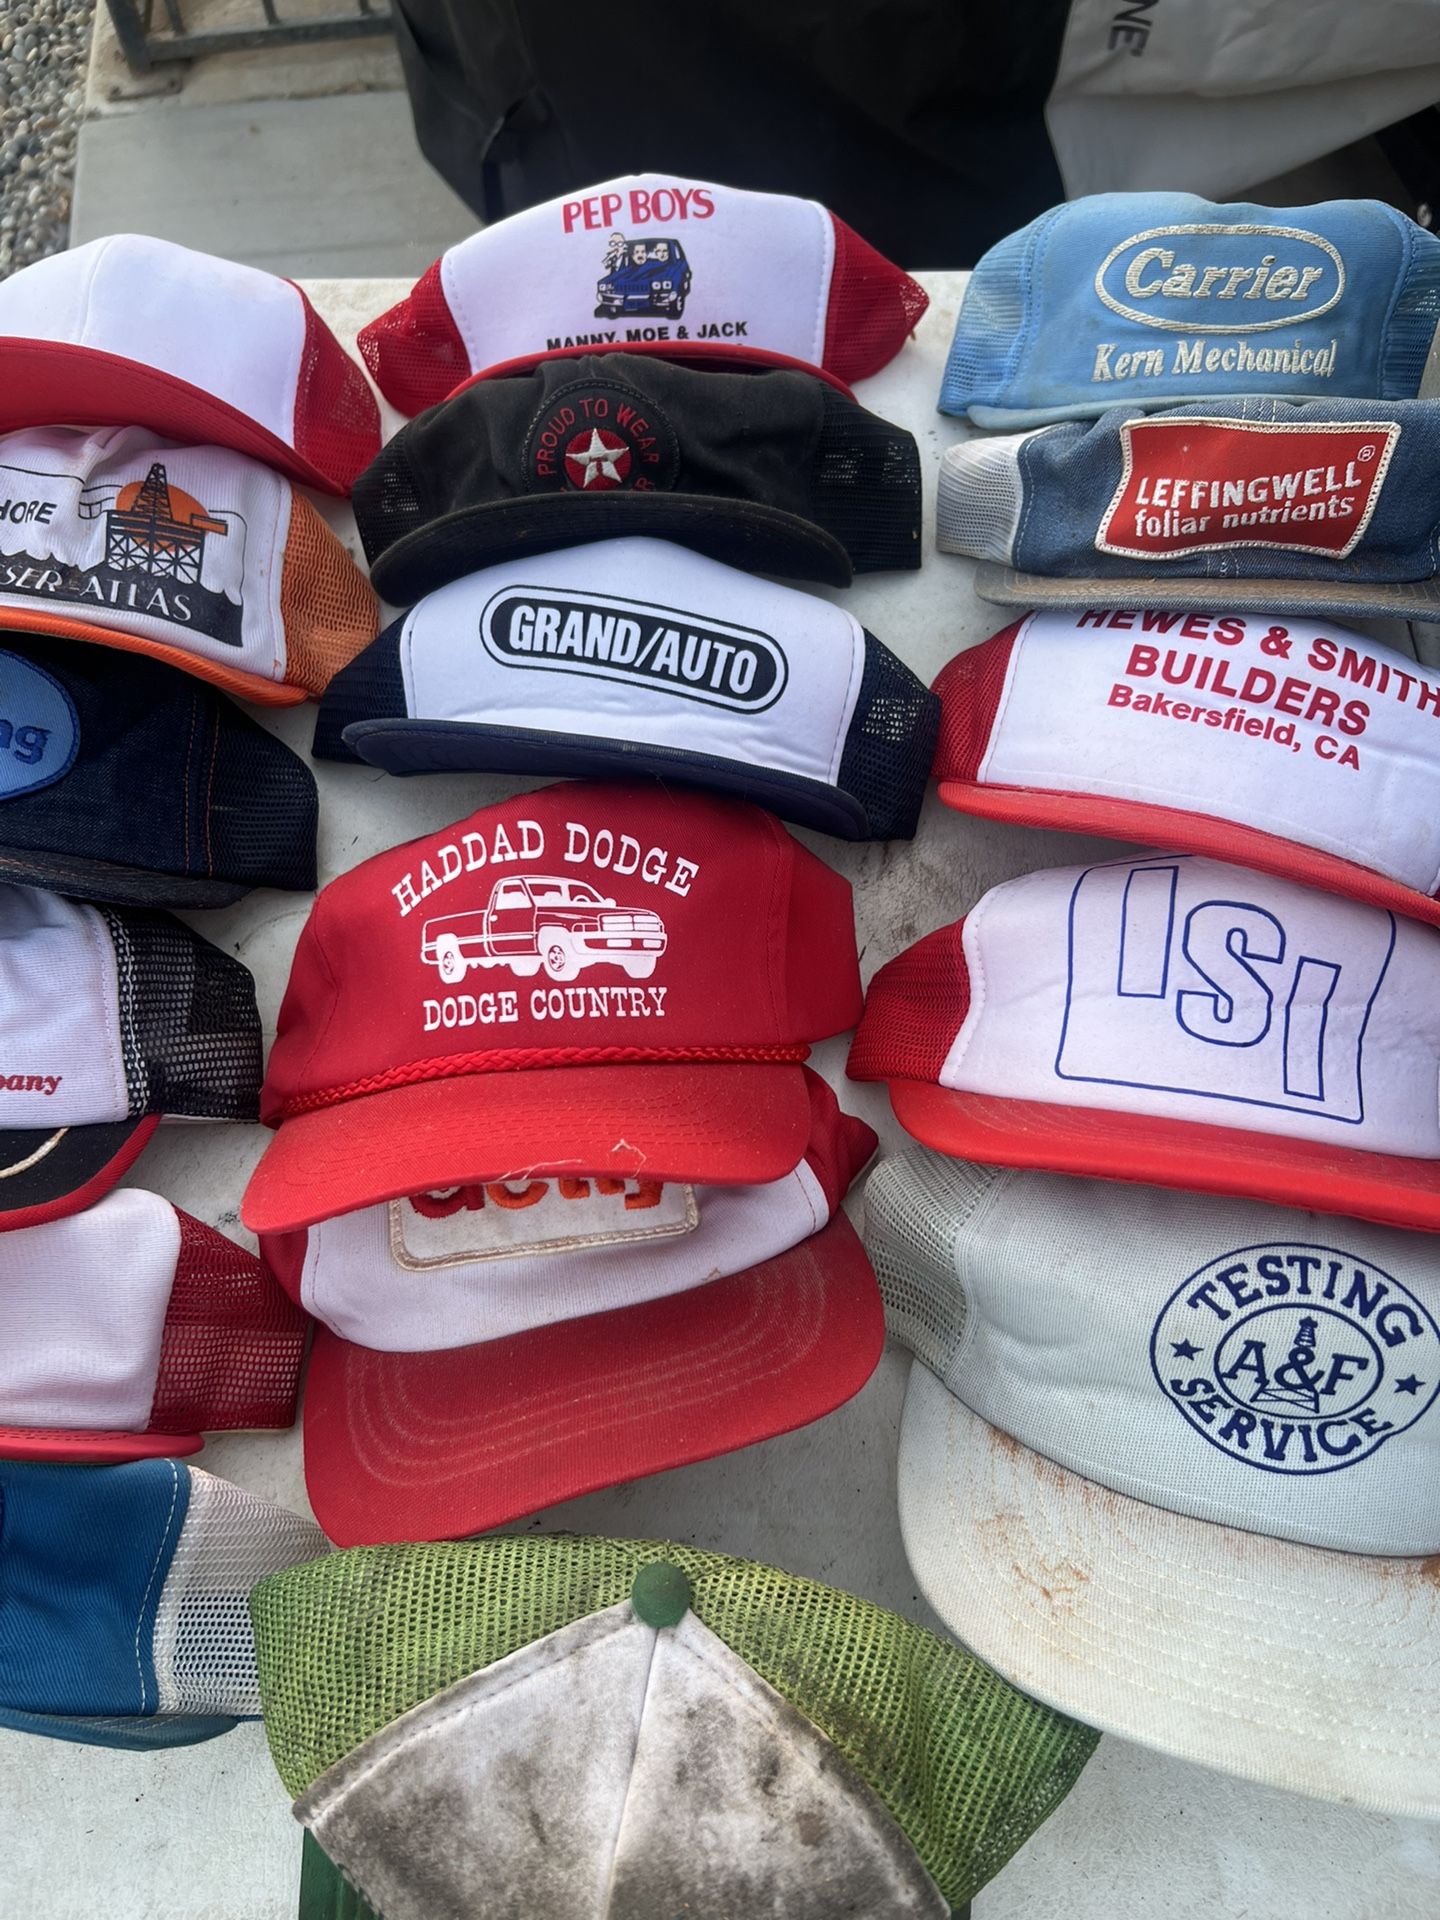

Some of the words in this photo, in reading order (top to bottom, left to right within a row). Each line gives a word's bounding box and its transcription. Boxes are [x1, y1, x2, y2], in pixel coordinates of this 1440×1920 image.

[563, 196, 622, 234] PEP
[629, 188, 716, 225] BOYS
[1125, 247, 1324, 301] Carrier
[626, 326, 670, 343] MOE
[677, 325, 689, 340] &
[697, 321, 748, 339] JACK
[1091, 342, 1165, 383] Kern
[1171, 338, 1338, 379] Mechanical
[536, 407, 576, 477] PROUD
[579, 398, 609, 419] TO
[615, 403, 660, 464] WEAR
[1134, 461, 1362, 510] LEFFINGWELL
[1134, 508, 1212, 538] foliar
[1221, 494, 1356, 530] nutrients
[0, 563, 63, 593] SER
[79, 575, 192, 622] ATLAS
[508, 604, 758, 695] GRAND/AUTO
[1075, 608, 1248, 647] HEWES
[1259, 625, 1293, 660] &
[1307, 638, 1440, 718] SMITH
[1124, 643, 1371, 737] BUILDERS
[1106, 683, 1301, 753] Bakersfield,
[1313, 734, 1361, 771] CA
[391, 819, 546, 918] HADDAD
[563, 821, 700, 898] DODGE
[422, 990, 519, 1032] DODGE
[530, 986, 668, 1021] COUNTRY
[1186, 1255, 1424, 1348] TESTING
[1221, 1339, 1370, 1396] A&F
[1170, 1377, 1395, 1463] SERVICE
